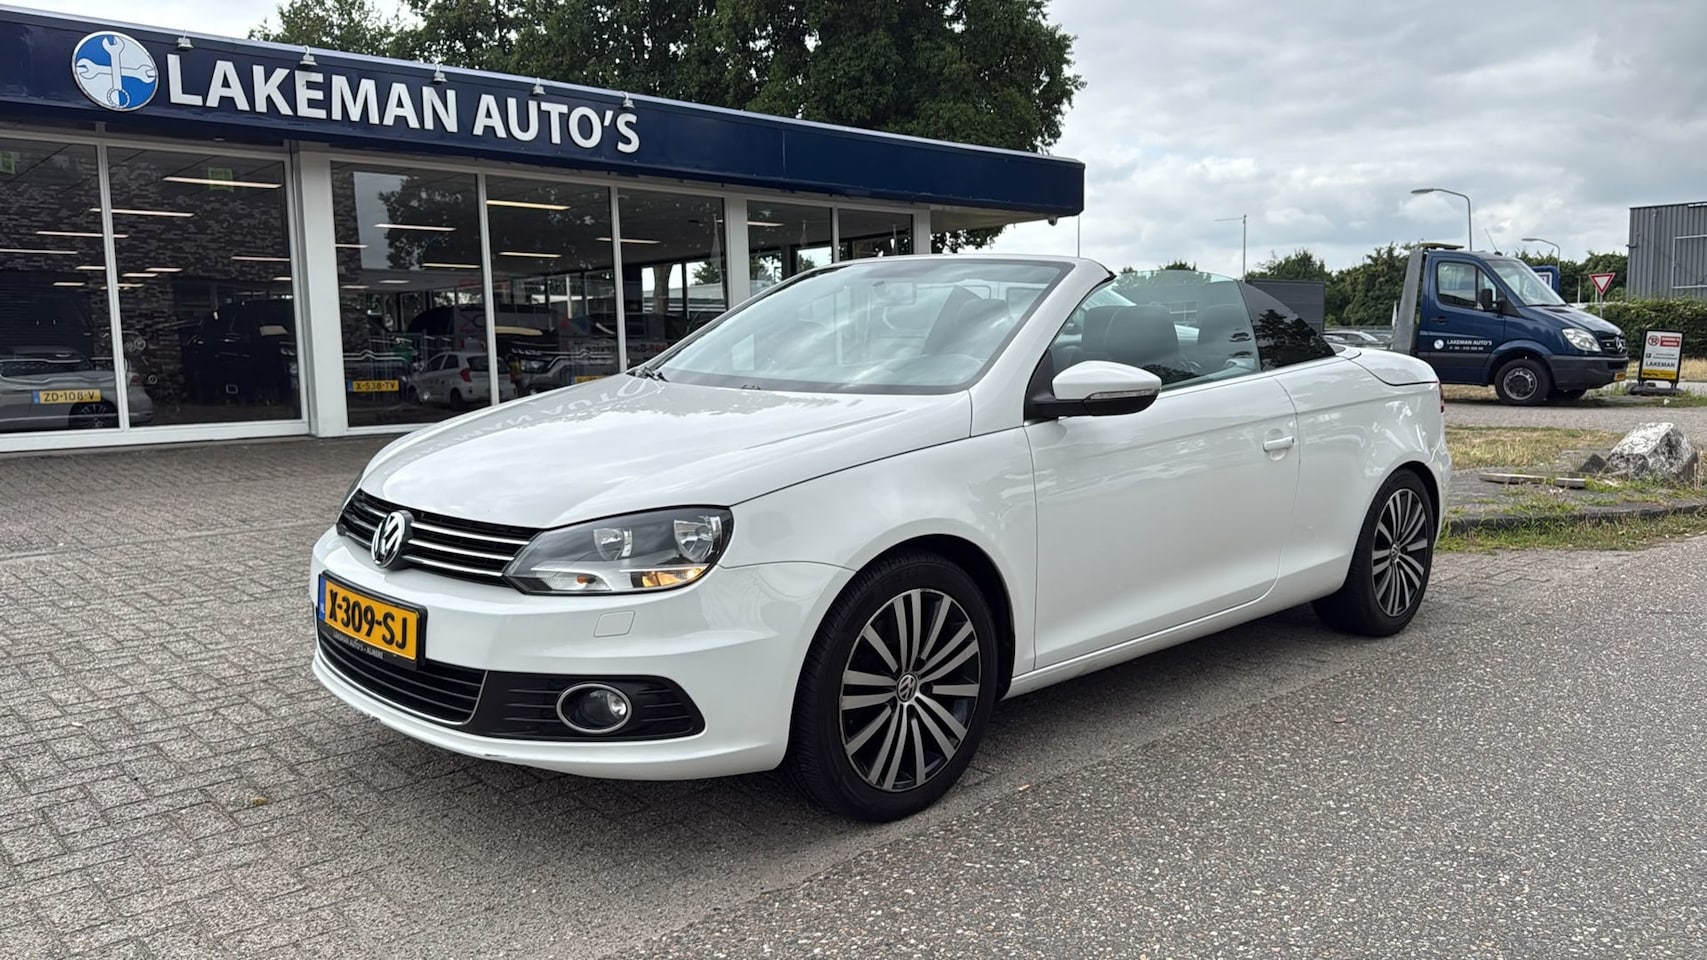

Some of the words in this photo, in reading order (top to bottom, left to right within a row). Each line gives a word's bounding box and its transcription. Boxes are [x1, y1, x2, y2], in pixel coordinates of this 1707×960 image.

[167, 53, 458, 133] LAKEMAN
[473, 93, 641, 154] AUTO'S
[1645, 360, 1676, 369] LAKEMAN
[43, 391, 95, 403] ZD-108-V
[329, 589, 407, 649] X-309-SJ
